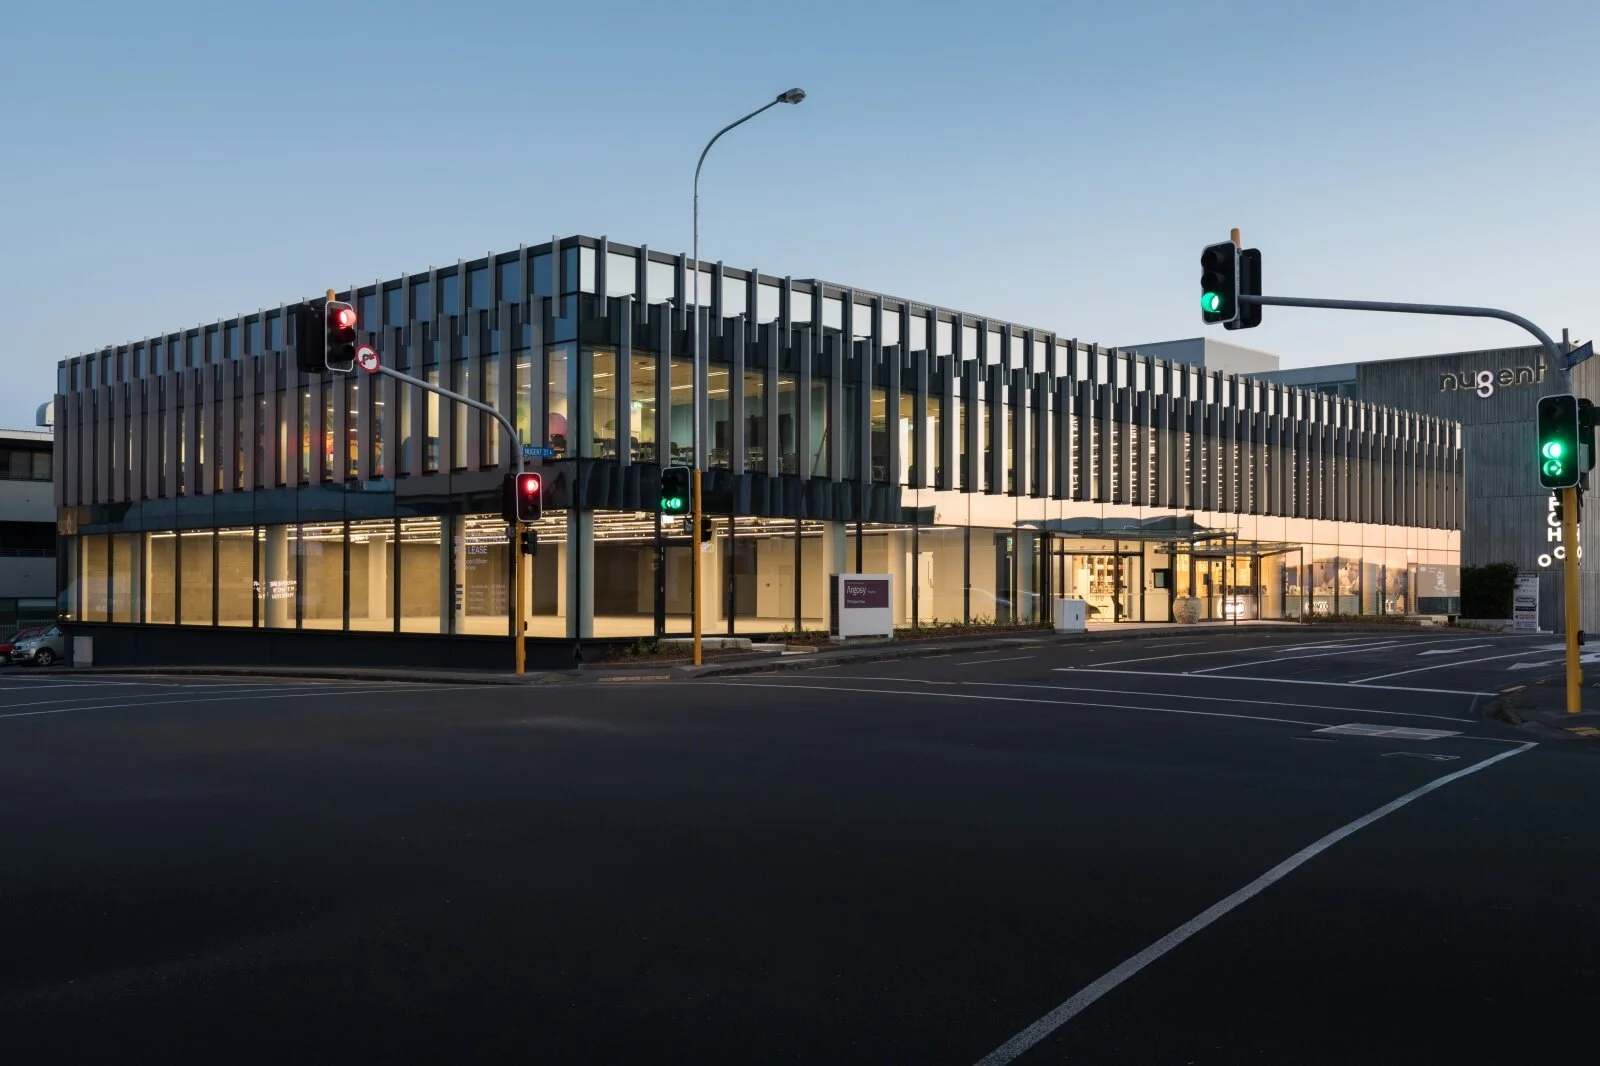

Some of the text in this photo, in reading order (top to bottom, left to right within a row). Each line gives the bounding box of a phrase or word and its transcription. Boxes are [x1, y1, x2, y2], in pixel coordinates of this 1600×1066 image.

[1440, 354, 1547, 398] nugent
[524, 447, 542, 456] NUGENT
[467, 545, 488, 555] LEASE
[846, 585, 867, 596] Argosy
